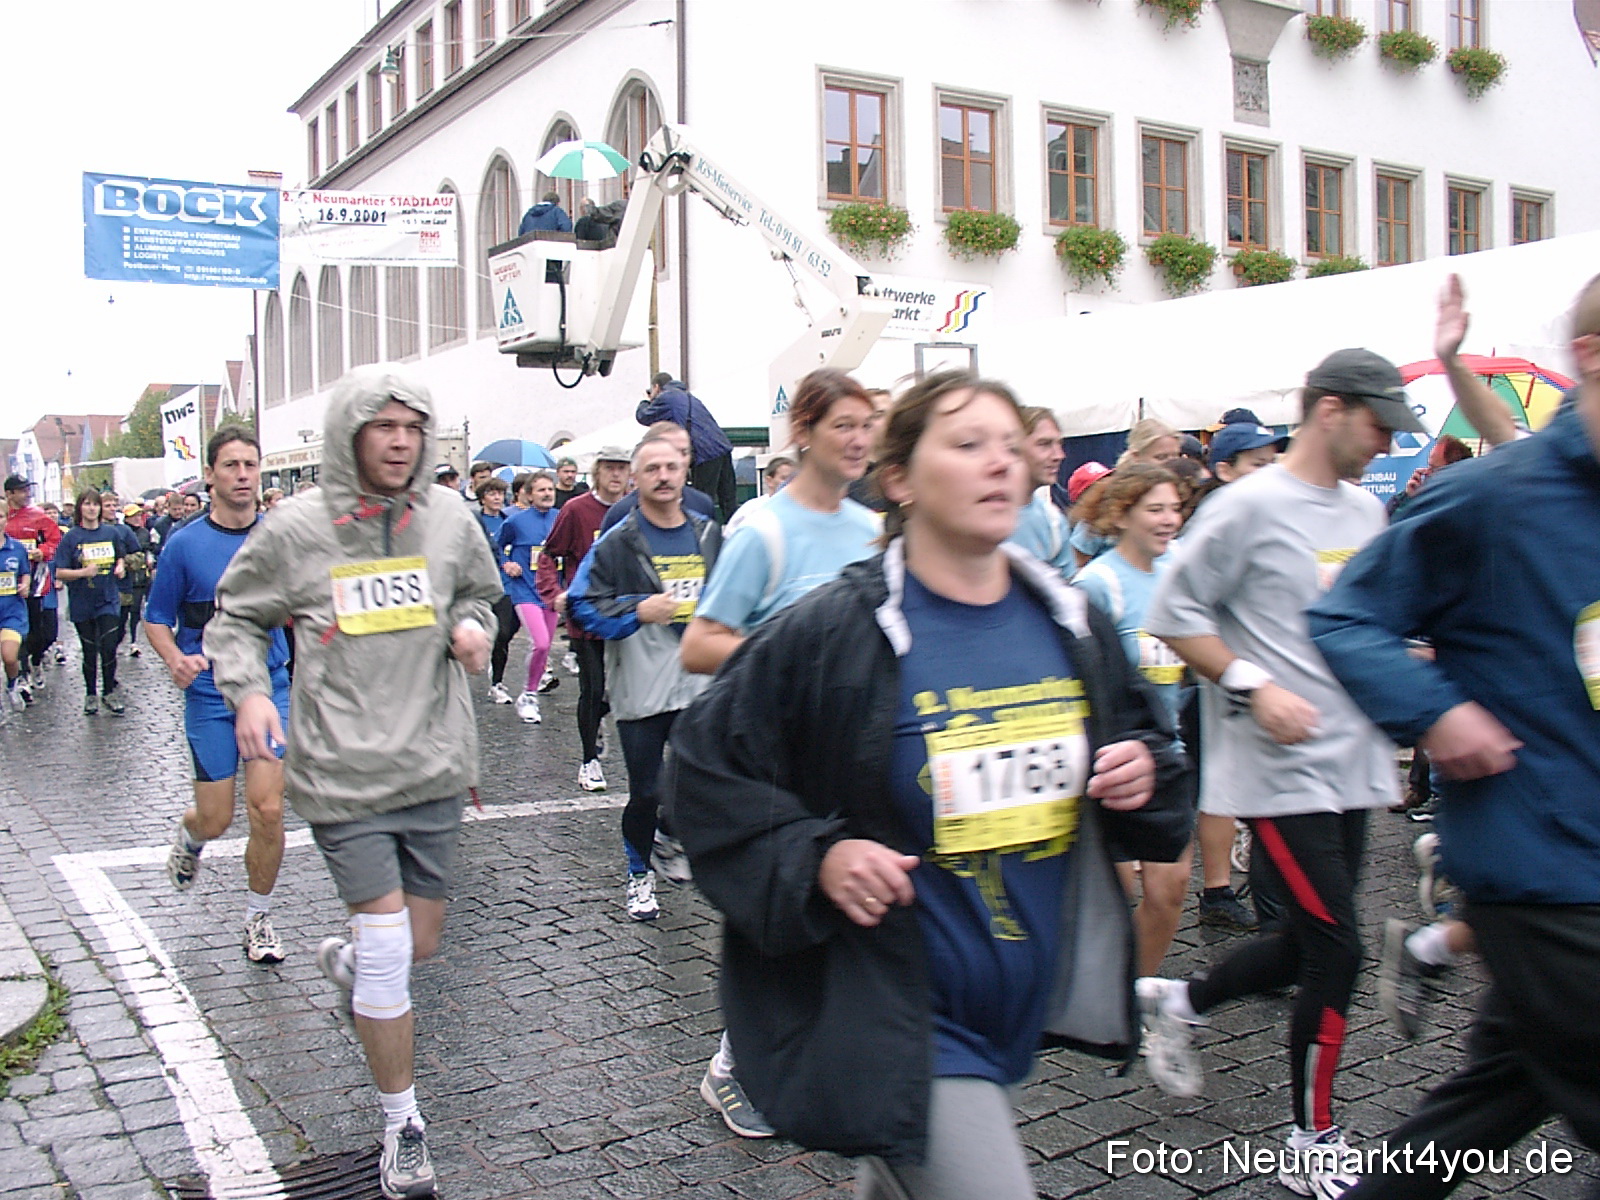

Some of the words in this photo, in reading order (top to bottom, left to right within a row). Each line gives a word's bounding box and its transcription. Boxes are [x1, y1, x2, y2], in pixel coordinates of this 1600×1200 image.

[93, 179, 268, 227] BOCK
[313, 192, 386, 207] Neumarkter
[318, 208, 387, 222] 16.9.2001
[892, 307, 921, 321] arkt
[353, 573, 423, 611] 1058
